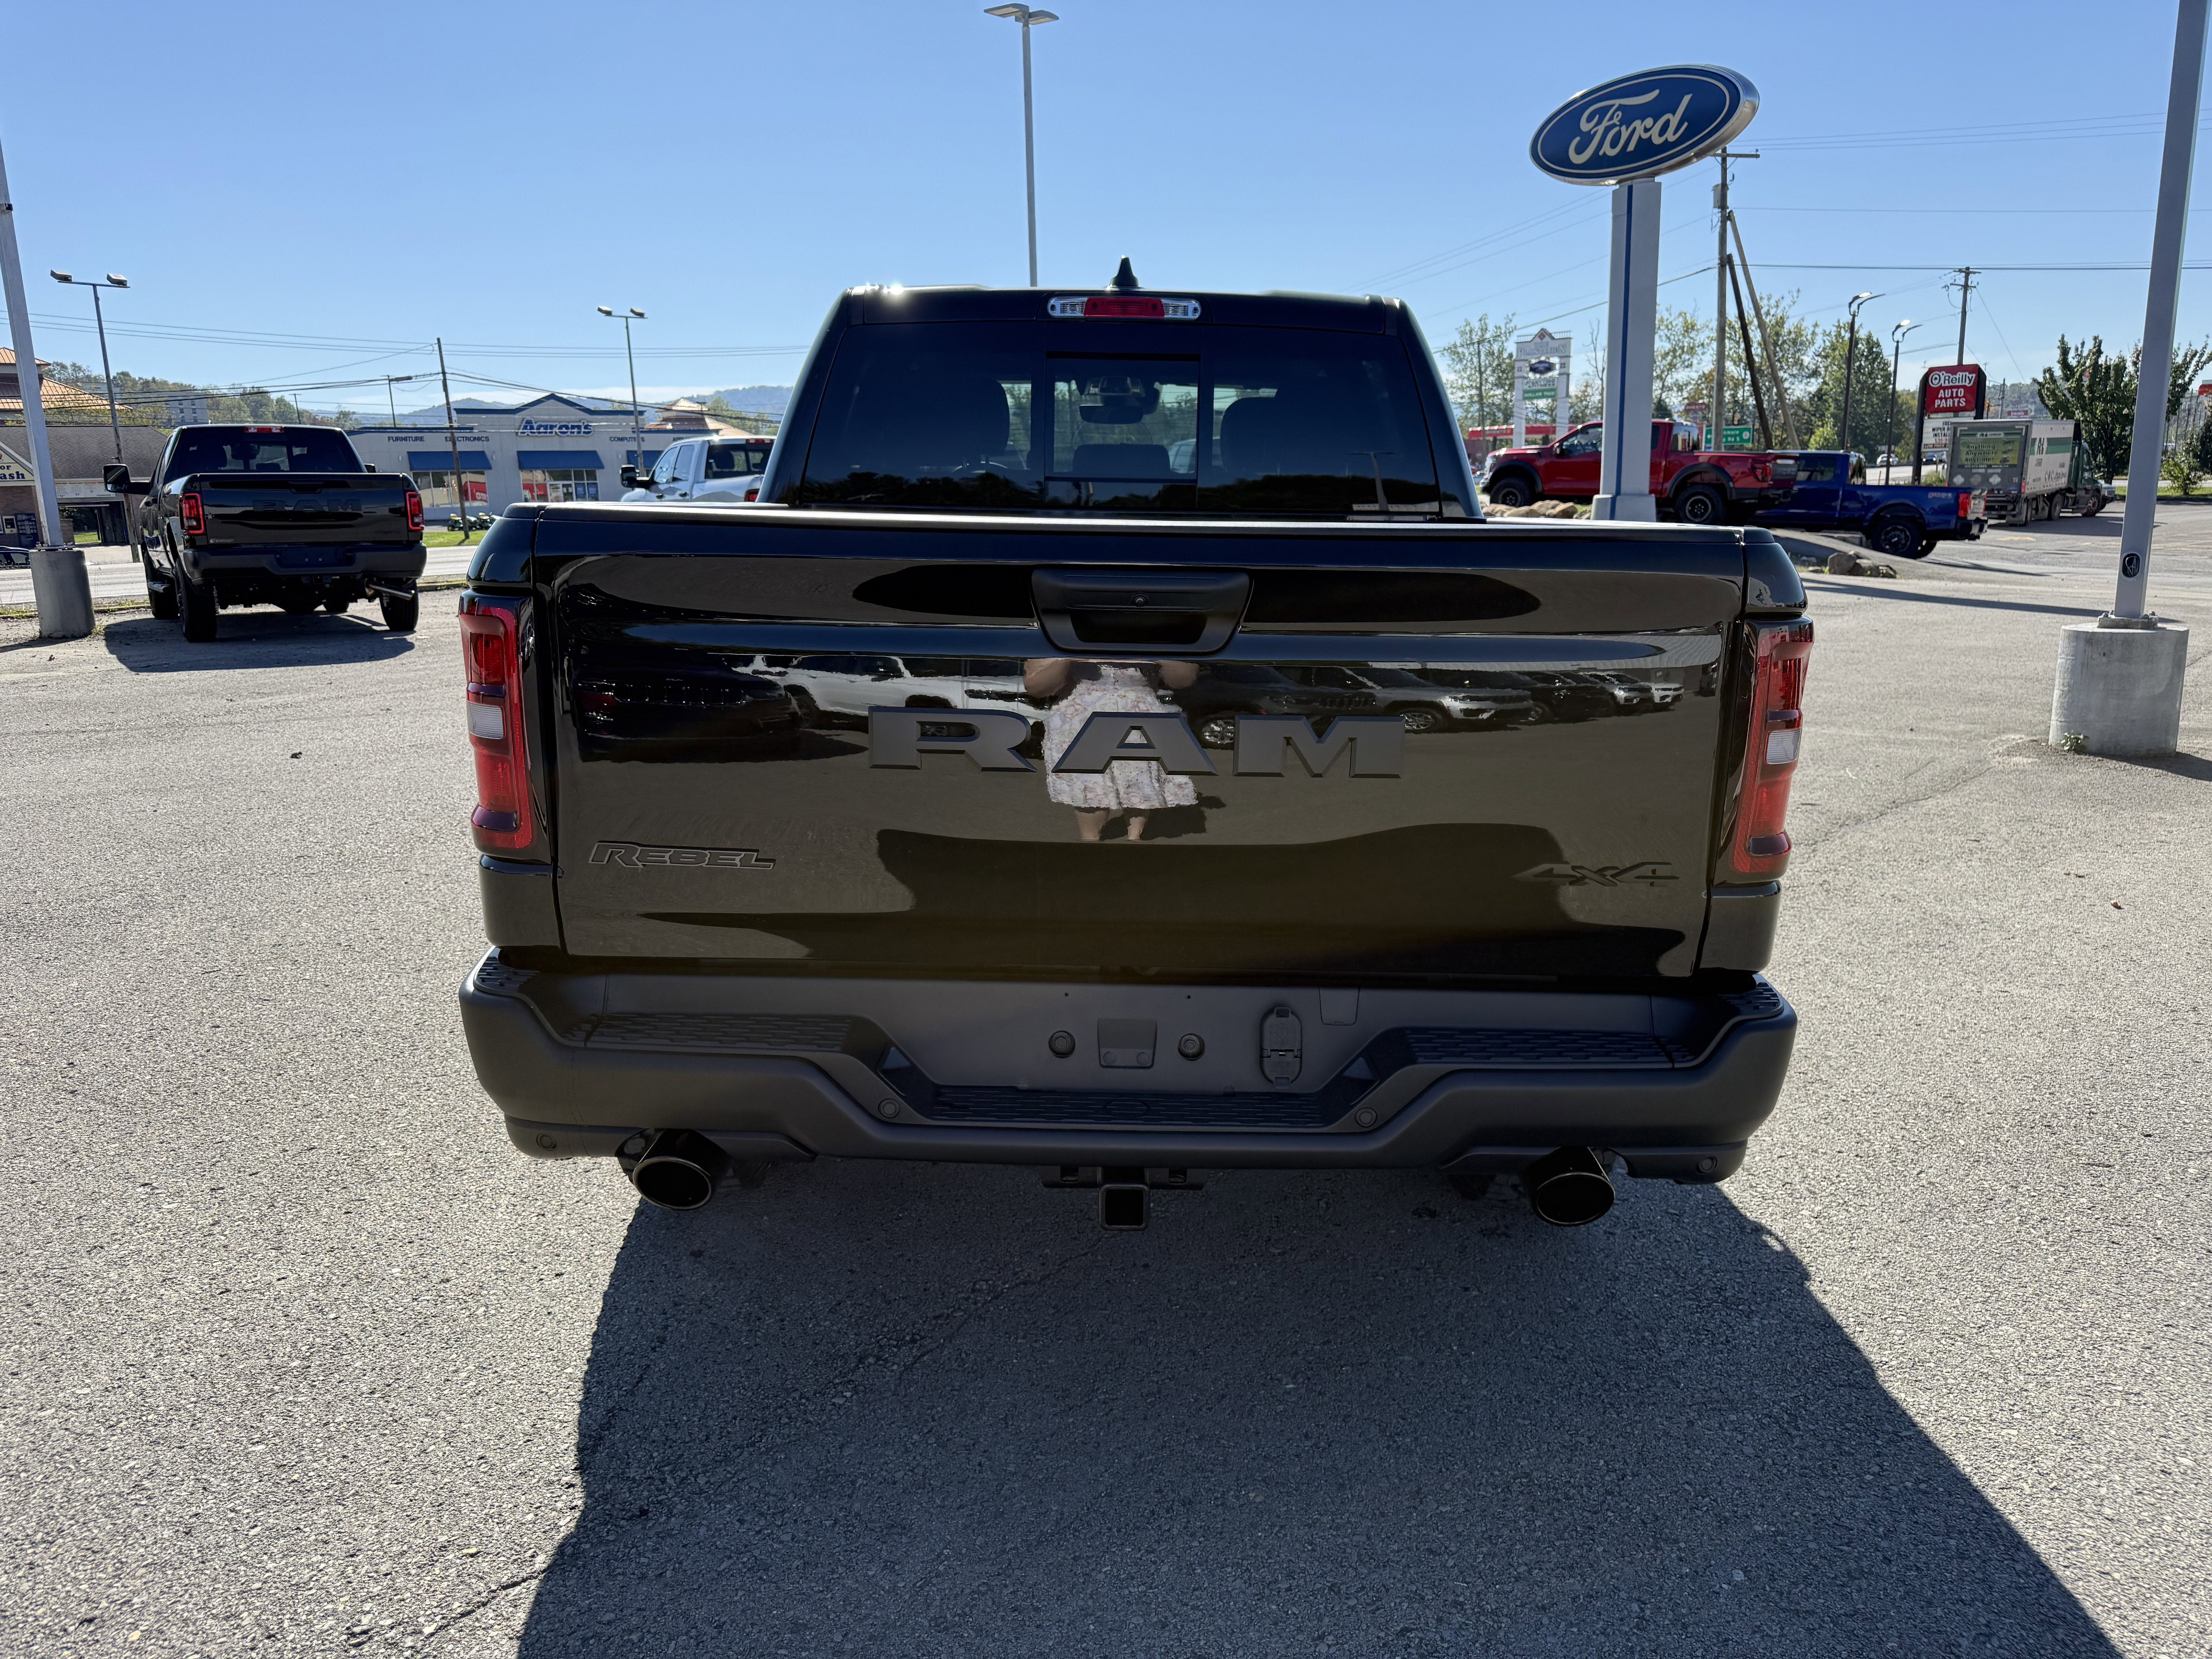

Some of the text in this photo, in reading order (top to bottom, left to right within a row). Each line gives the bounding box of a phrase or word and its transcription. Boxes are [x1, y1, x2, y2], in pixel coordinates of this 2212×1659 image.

[1569, 89, 1693, 164] Ford
[1929, 371, 1975, 387] O'Reilly
[1938, 388, 1964, 398] AUTO
[1935, 398, 1966, 408] PARTS
[518, 418, 593, 436] Aaron's
[252, 499, 362, 512] RAM
[869, 706, 1406, 779] RAM
[589, 840, 776, 870] REBEL
